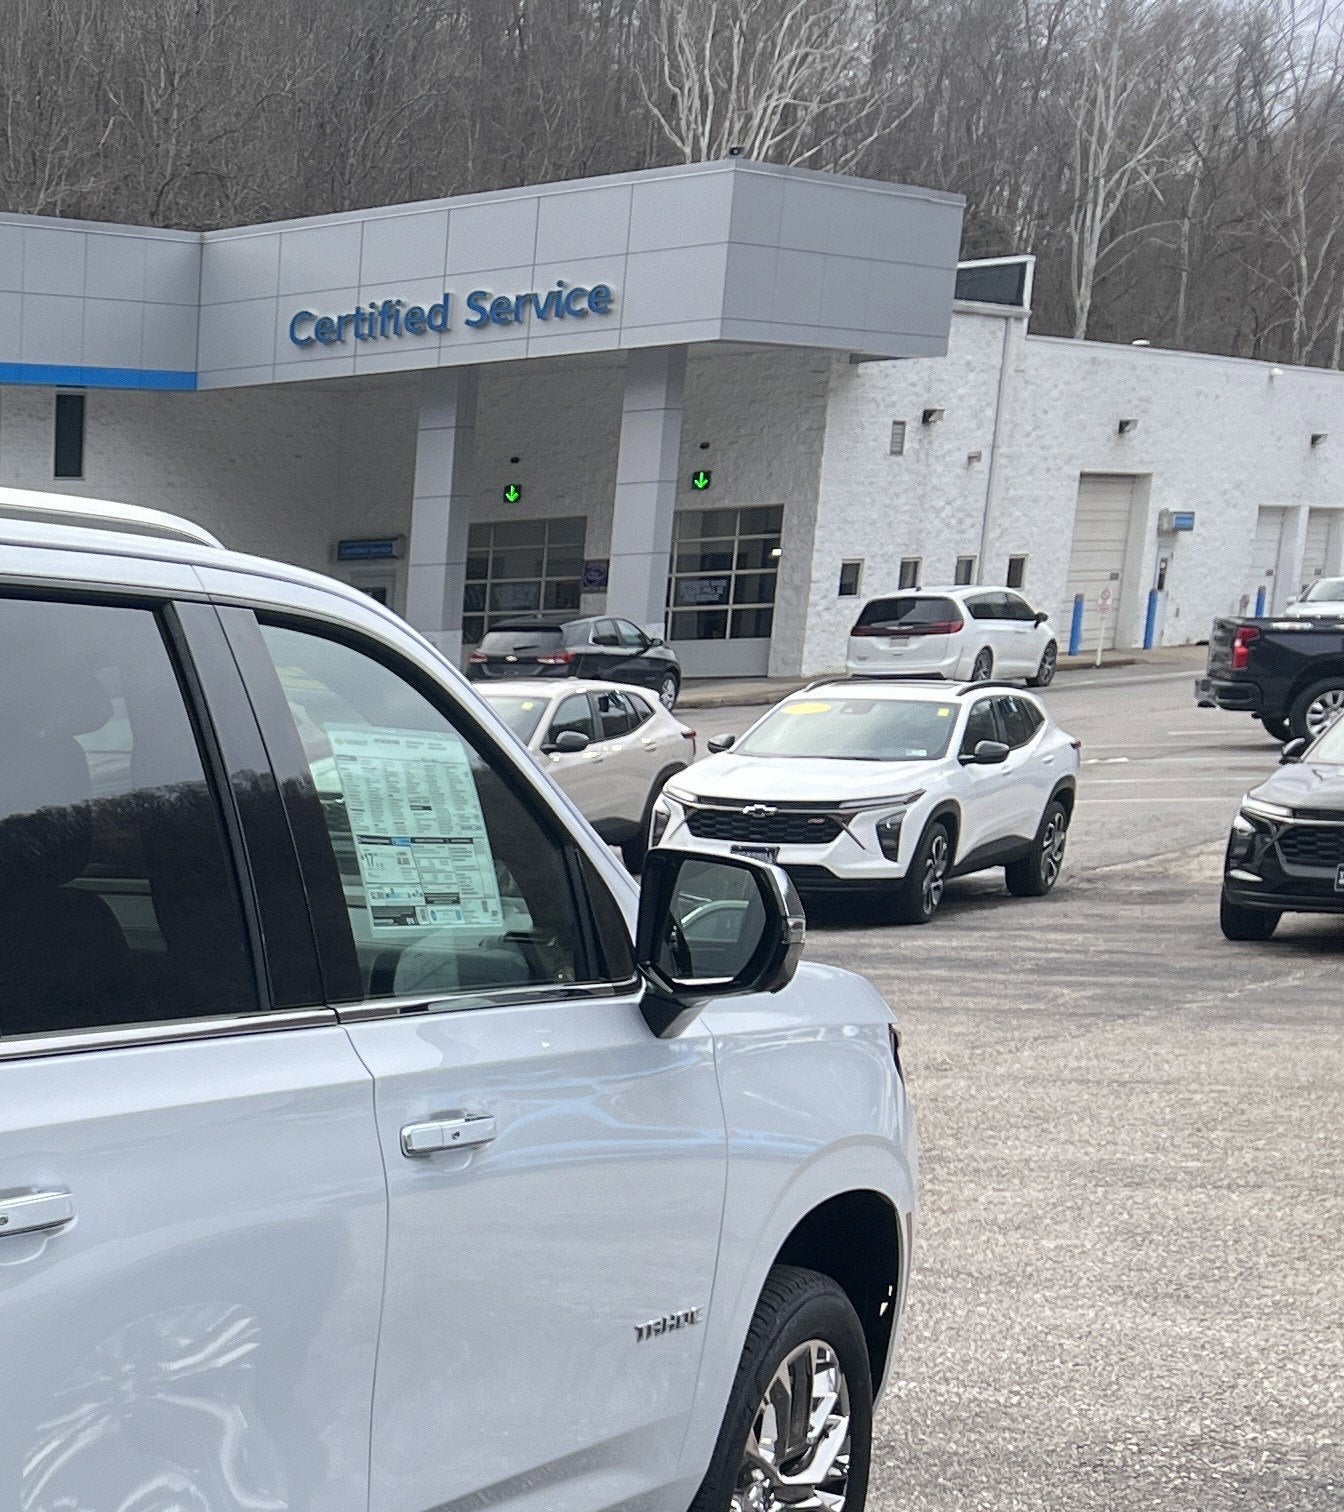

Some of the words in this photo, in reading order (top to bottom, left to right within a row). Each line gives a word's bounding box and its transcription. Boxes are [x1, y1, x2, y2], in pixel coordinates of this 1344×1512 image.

[289, 291, 450, 348] Certified
[464, 279, 613, 329] Service
[634, 1306, 704, 1343] TAHOE
